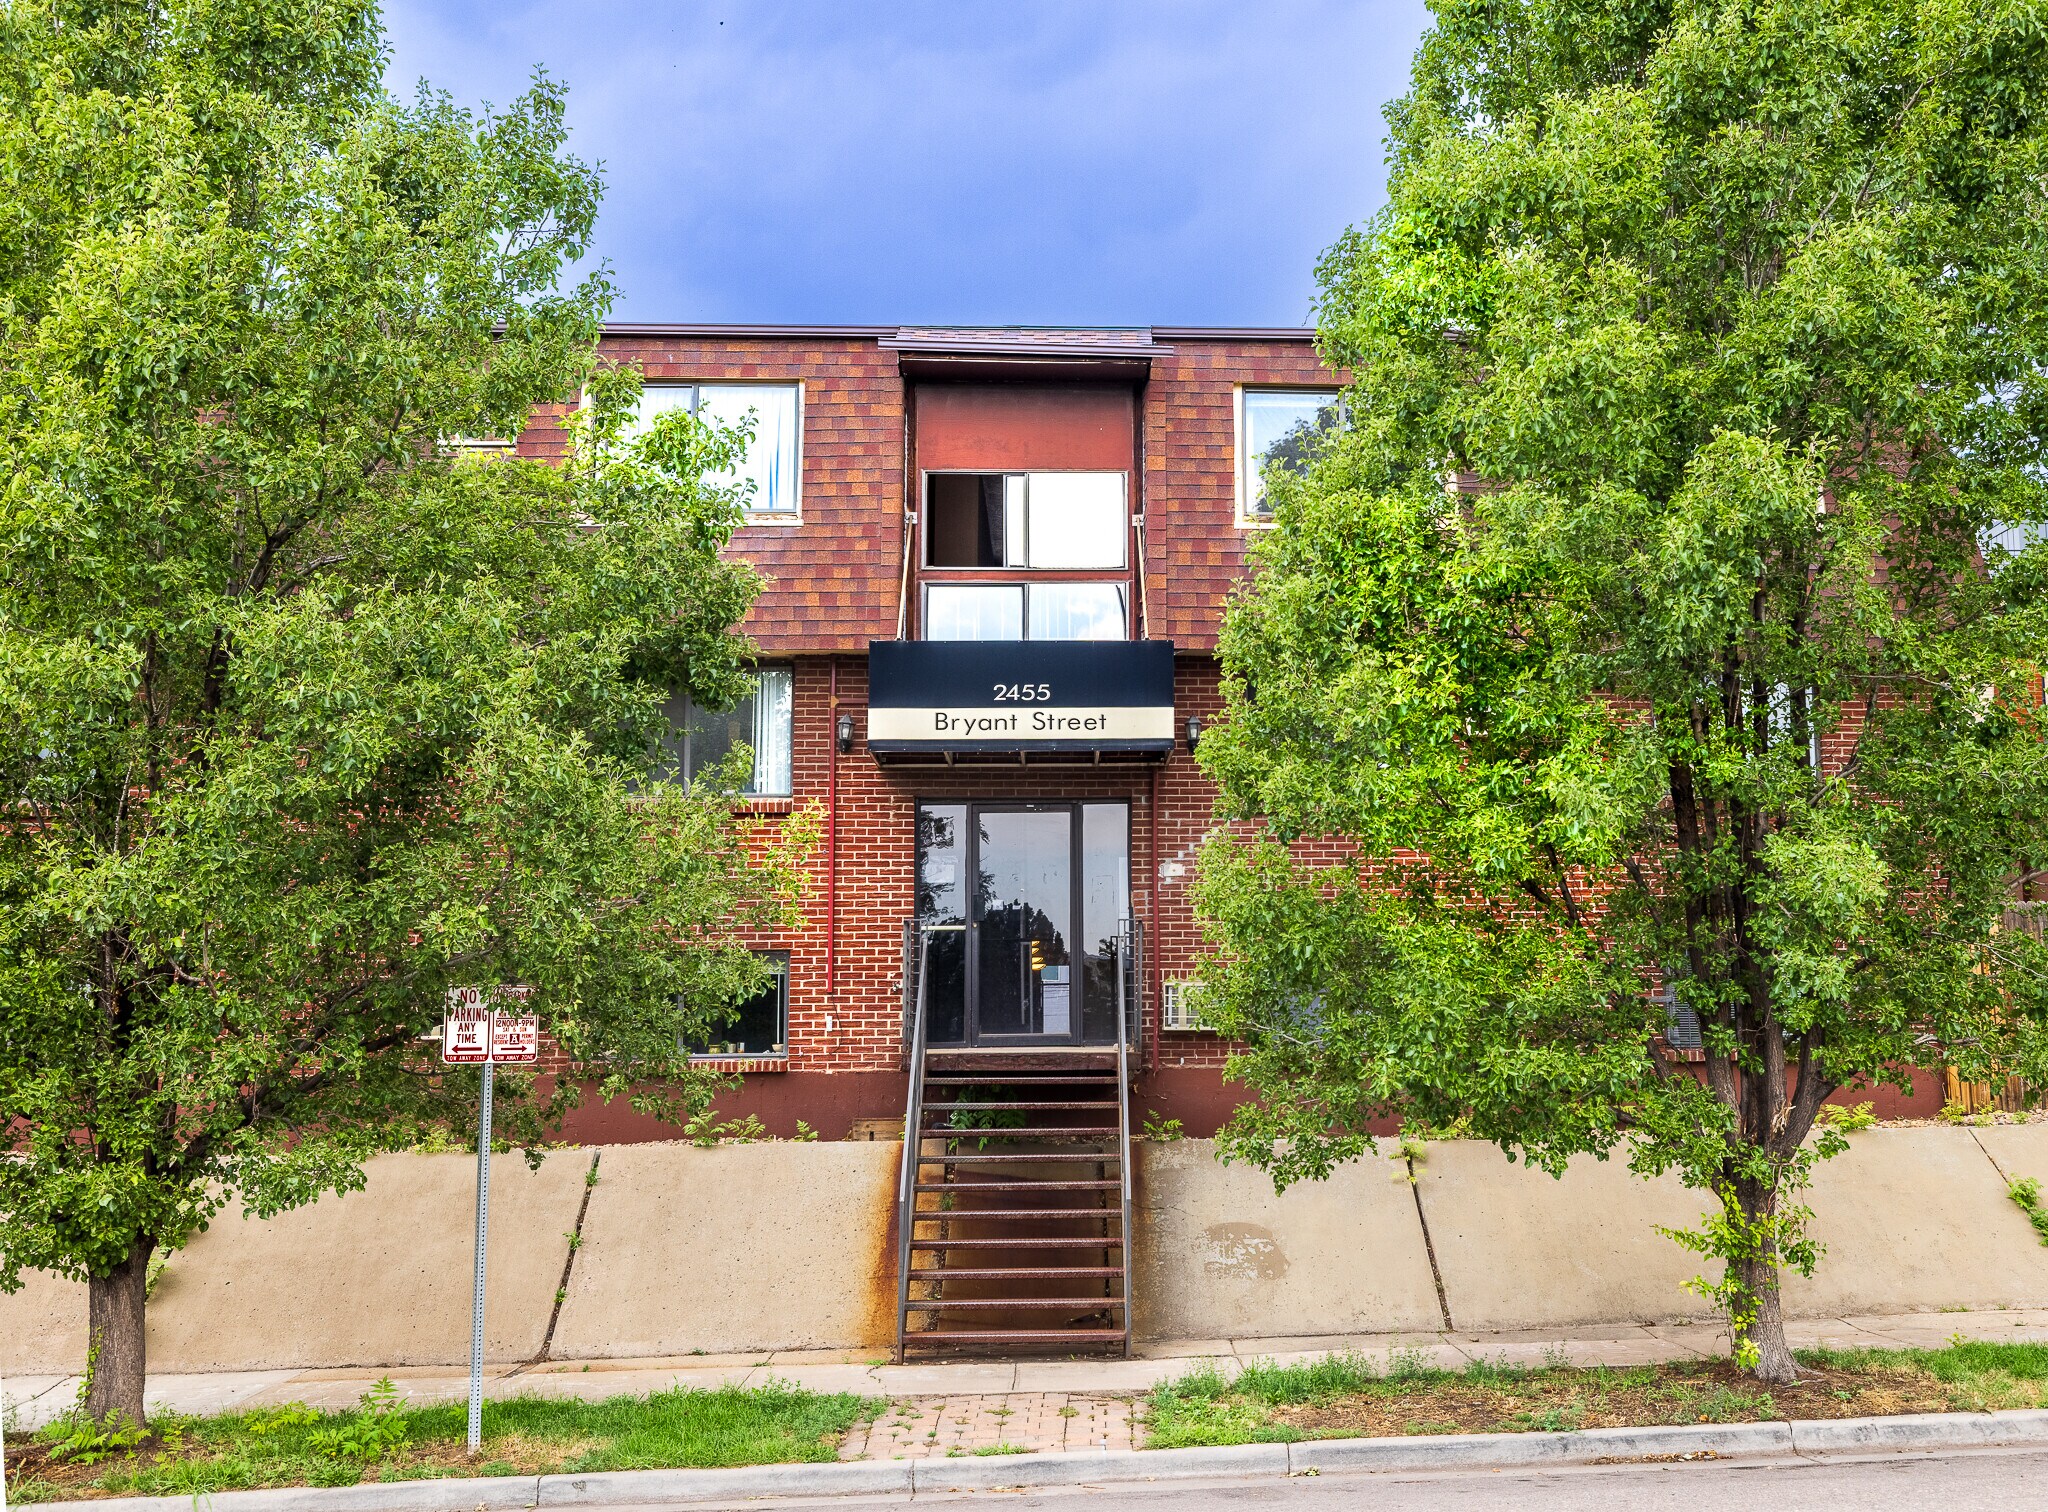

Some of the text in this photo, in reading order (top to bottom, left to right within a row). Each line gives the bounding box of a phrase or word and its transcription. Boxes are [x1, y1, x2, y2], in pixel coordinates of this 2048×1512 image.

[993, 684, 1050, 701] 2455
[934, 711, 1107, 735] Bryant Street
[460, 989, 477, 1004] NO
[448, 1008, 487, 1022] PARKING
[457, 1022, 476, 1033] ANY
[456, 1033, 477, 1044] TIME
[510, 1034, 519, 1044] A
